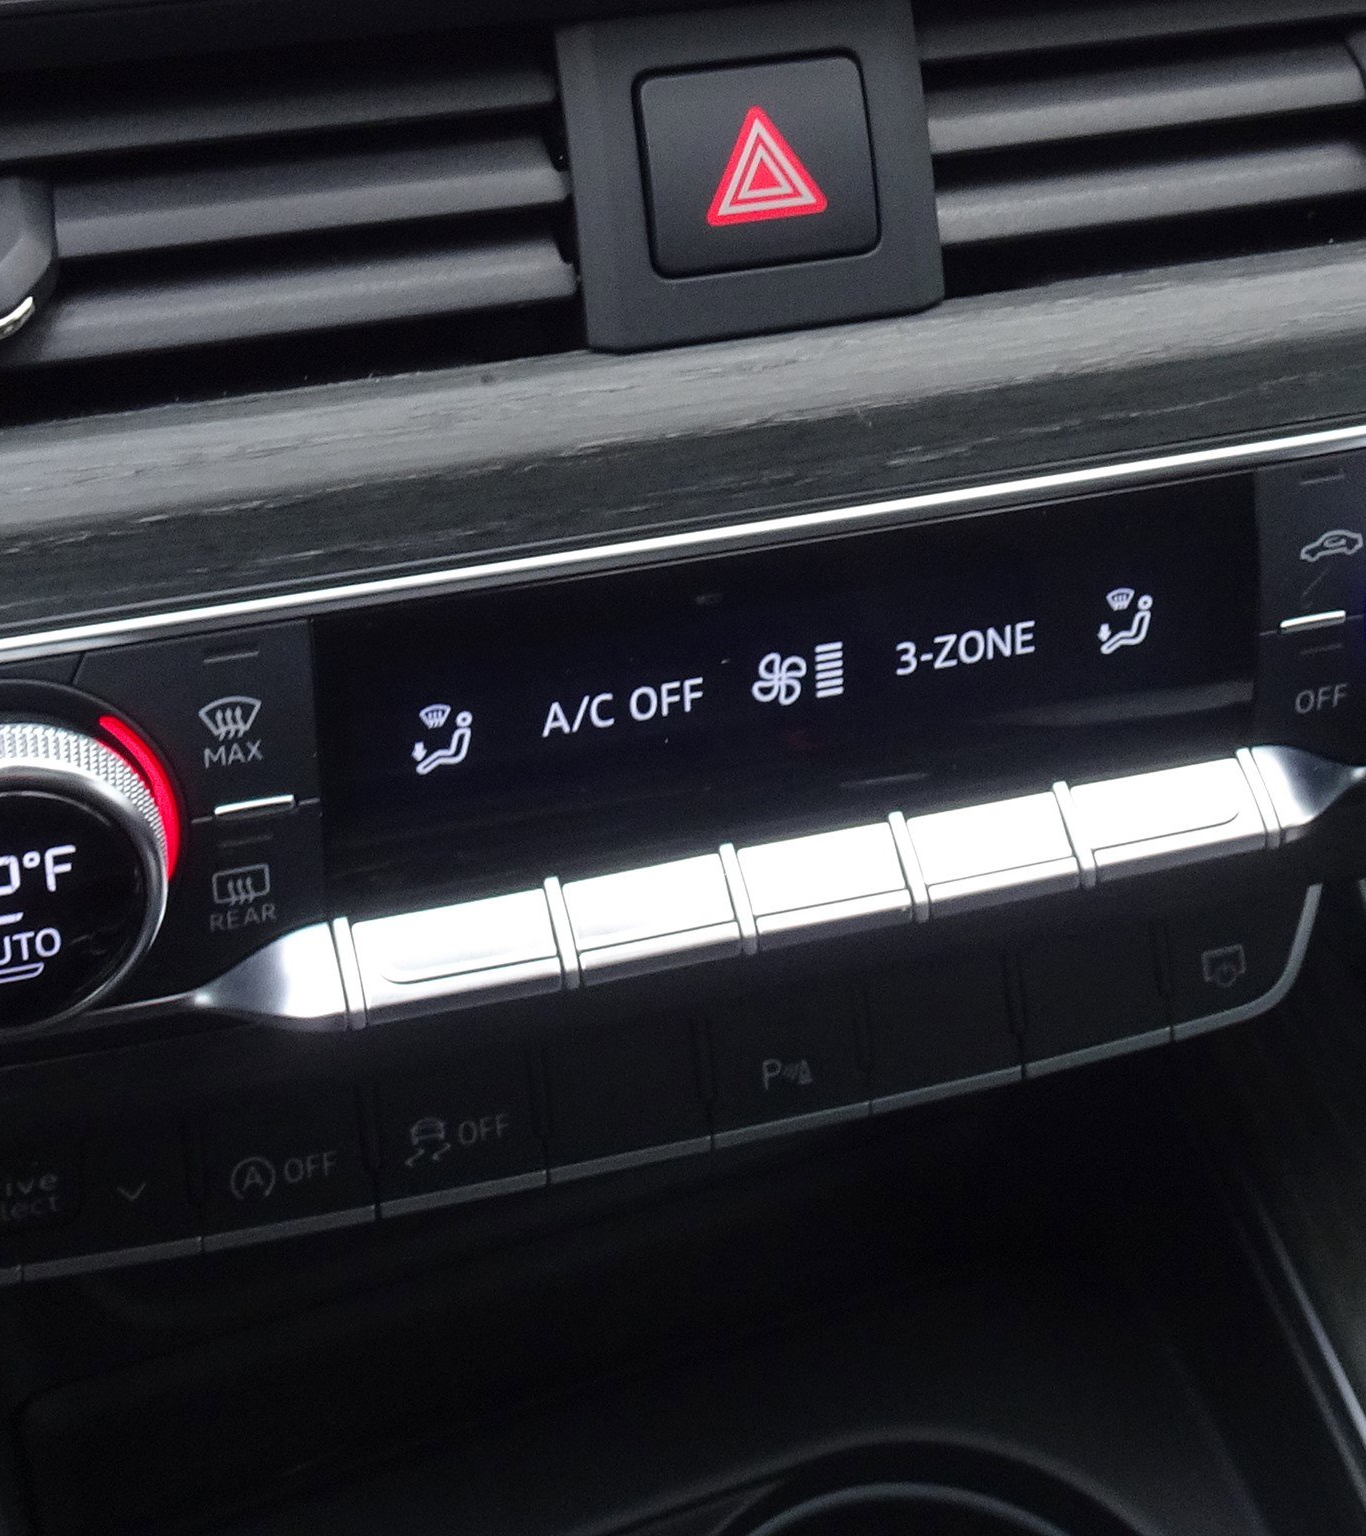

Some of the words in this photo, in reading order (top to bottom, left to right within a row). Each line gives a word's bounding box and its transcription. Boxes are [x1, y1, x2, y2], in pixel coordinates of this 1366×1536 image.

[894, 619, 1036, 677] 3-ZONE
[541, 692, 616, 738] A/C
[628, 676, 704, 722] OFF
[1295, 682, 1349, 714] OFF
[202, 739, 264, 769] MAX
[209, 902, 277, 932] REAR
[458, 1113, 510, 1145] OFF
[283, 1150, 337, 1183] OFF
